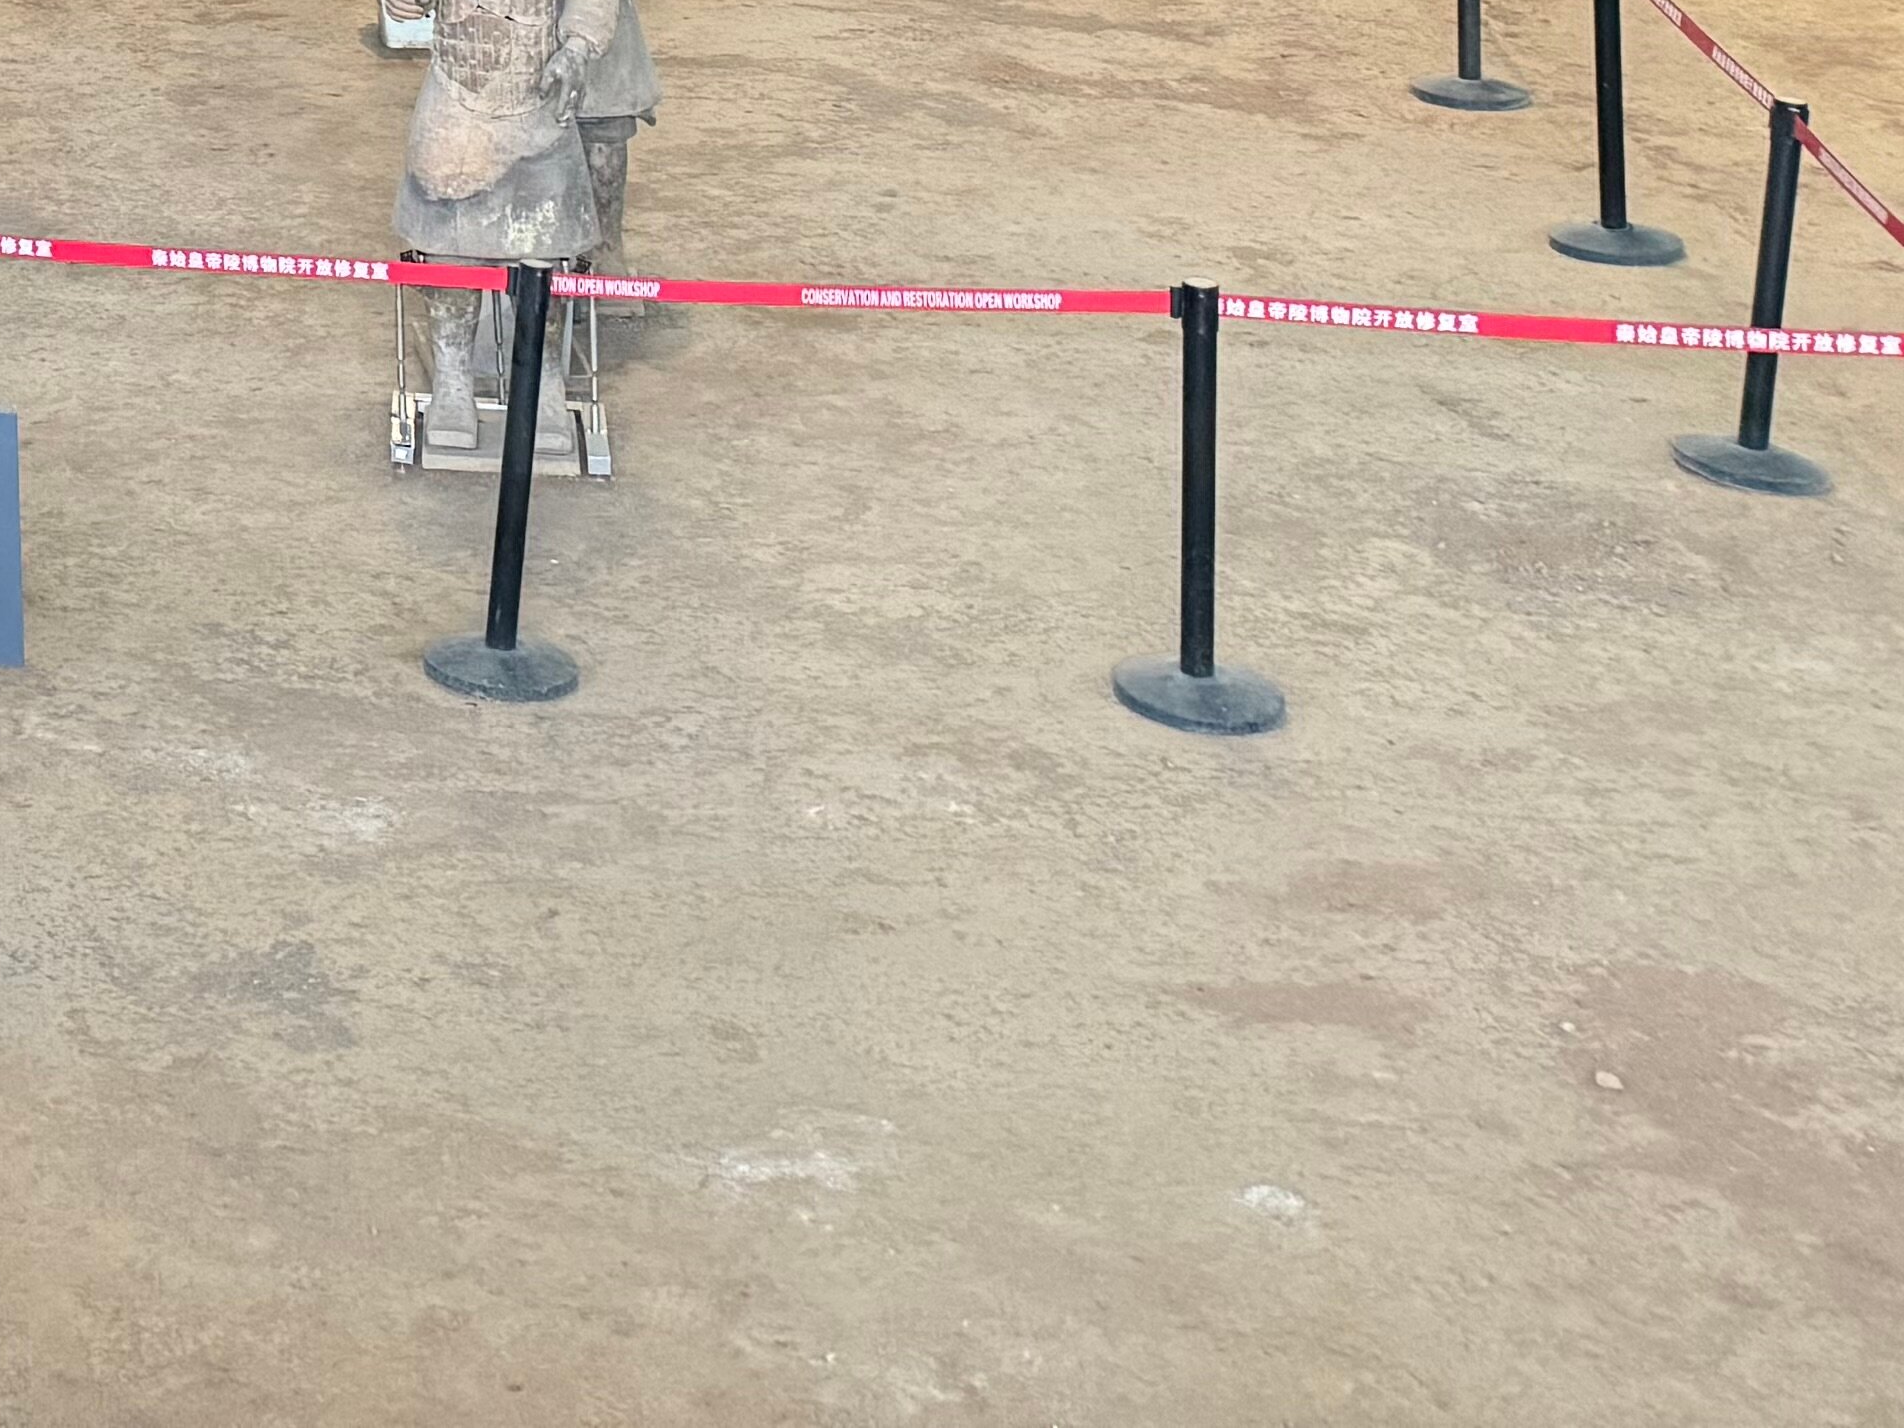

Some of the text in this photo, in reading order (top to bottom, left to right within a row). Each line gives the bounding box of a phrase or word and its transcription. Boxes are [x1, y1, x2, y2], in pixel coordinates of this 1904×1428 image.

[577, 277, 603, 295] OPEN
[605, 279, 661, 297] WORKSHOP
[801, 288, 1062, 310] CONSERVATION AND RESTORATION OPEN WORKSHOP
